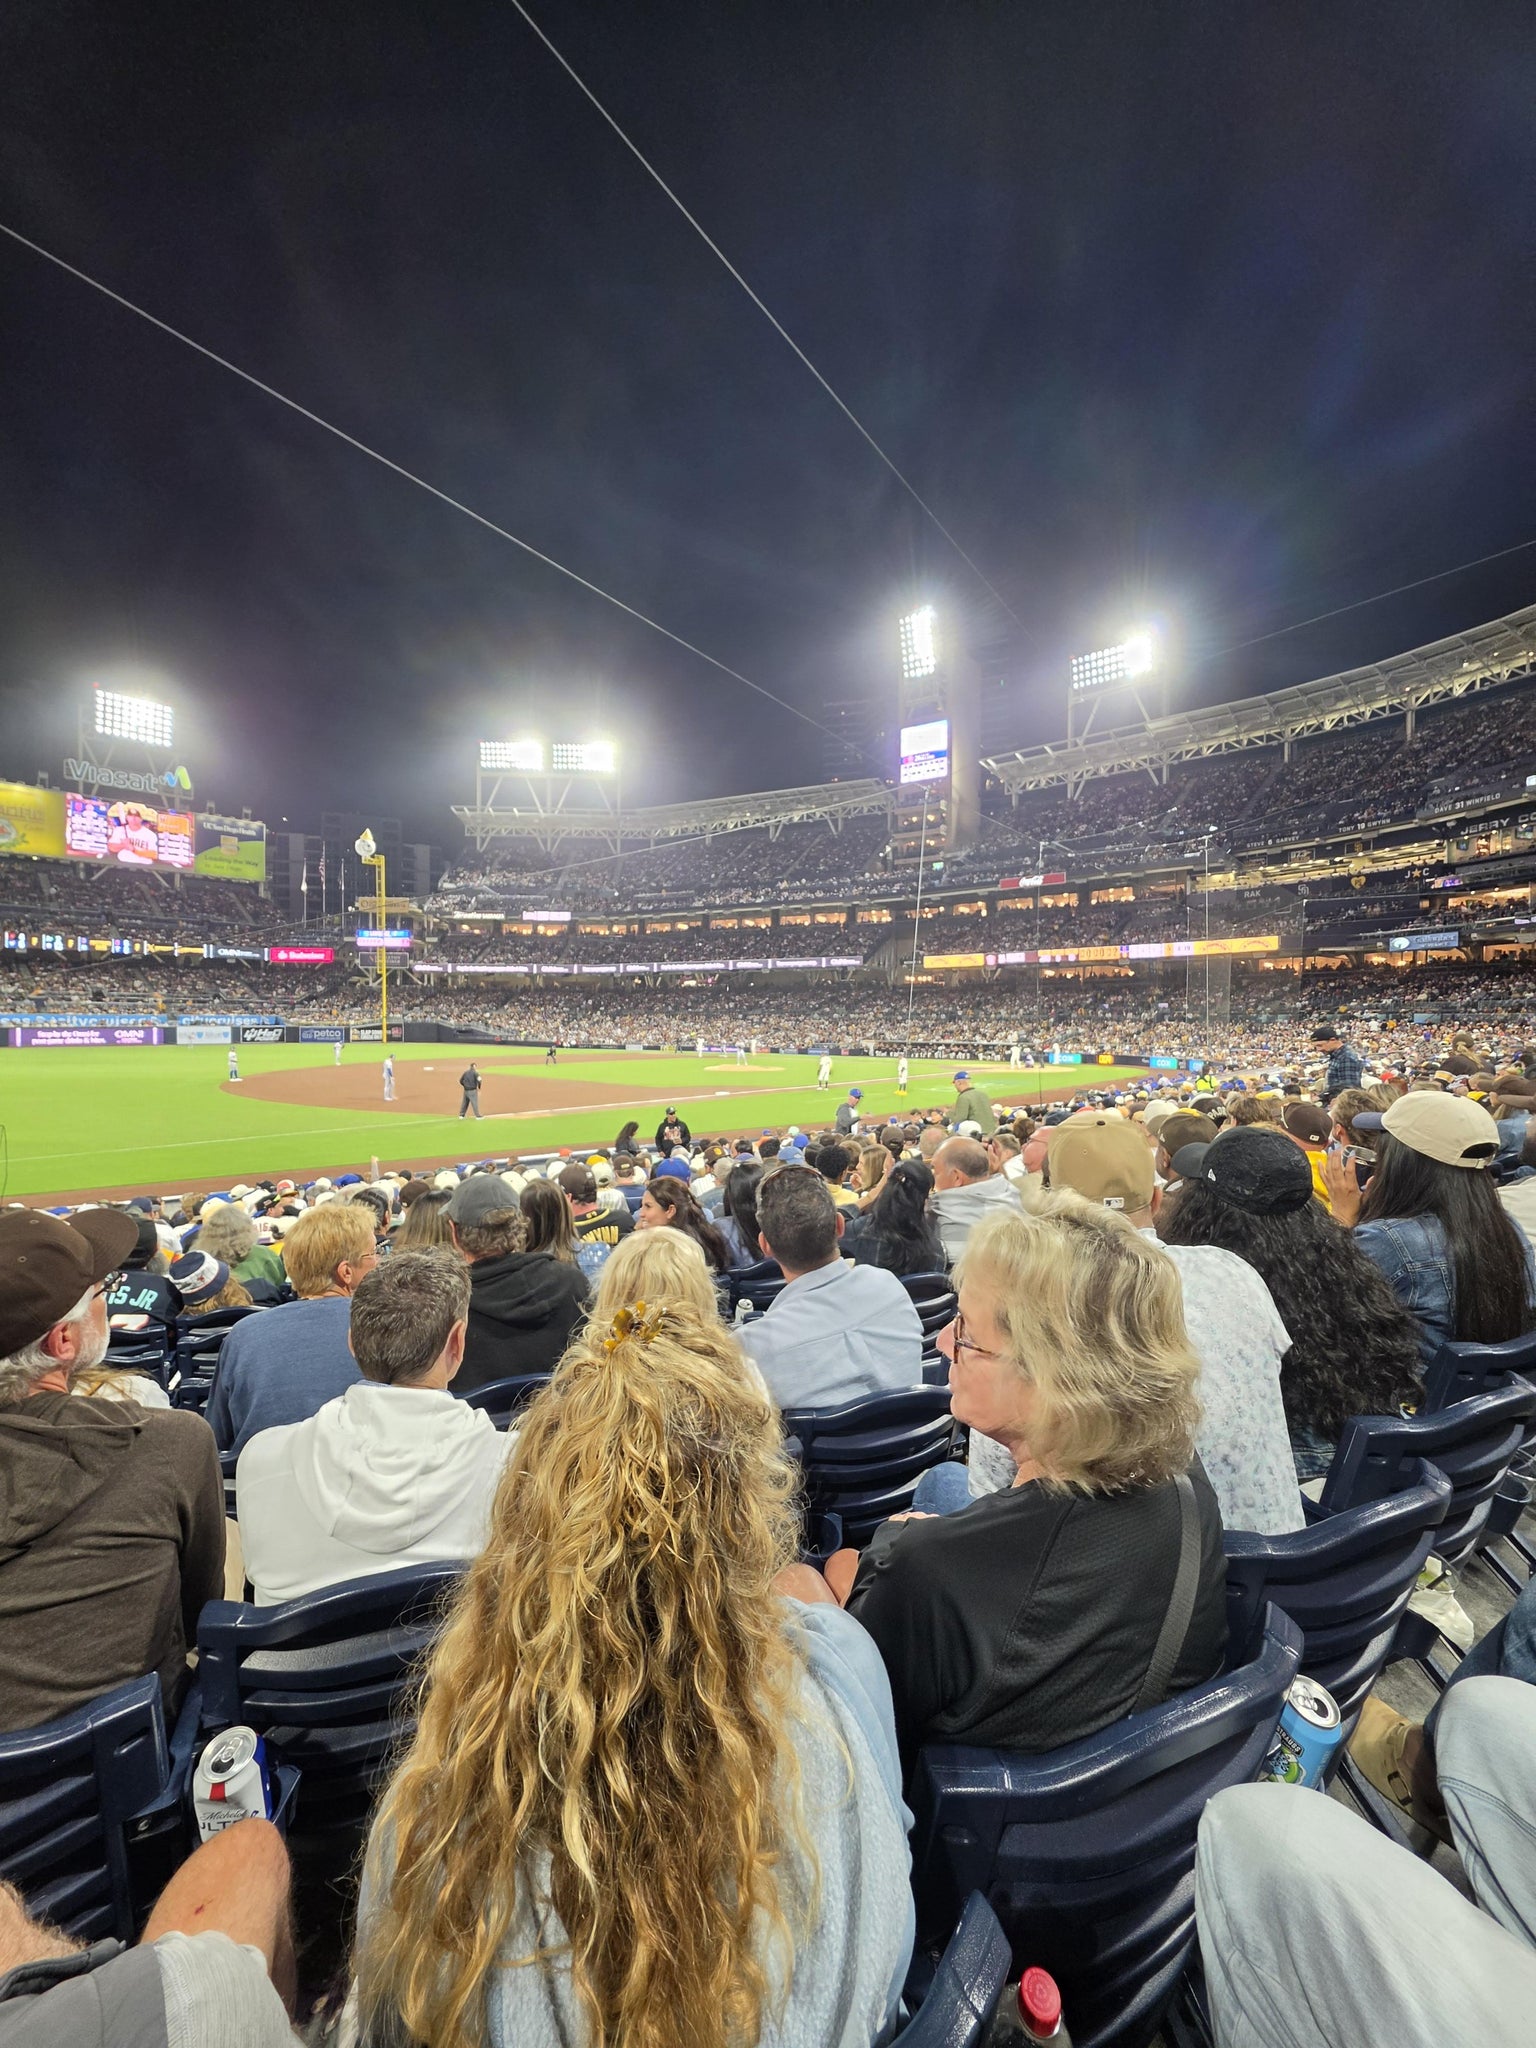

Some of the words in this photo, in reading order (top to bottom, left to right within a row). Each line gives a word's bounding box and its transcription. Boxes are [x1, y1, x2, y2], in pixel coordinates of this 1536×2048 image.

[67, 758, 158, 793] Viasat
[1434, 805, 1452, 814] DAVE
[1455, 800, 1464, 810] 31
[1465, 793, 1501, 807] WINFIELD
[1338, 825, 1355, 833] TONY
[1367, 818, 1391, 828] GWYNN
[1460, 817, 1510, 835] JERRY
[1275, 835, 1300, 844] GARVEY
[1243, 889, 1261, 899] RAK
[114, 1029, 144, 1039] OMNI
[313, 1028, 341, 1039] petco
[1156, 1059, 1171, 1067] COX
[107, 1285, 131, 1305] IS
